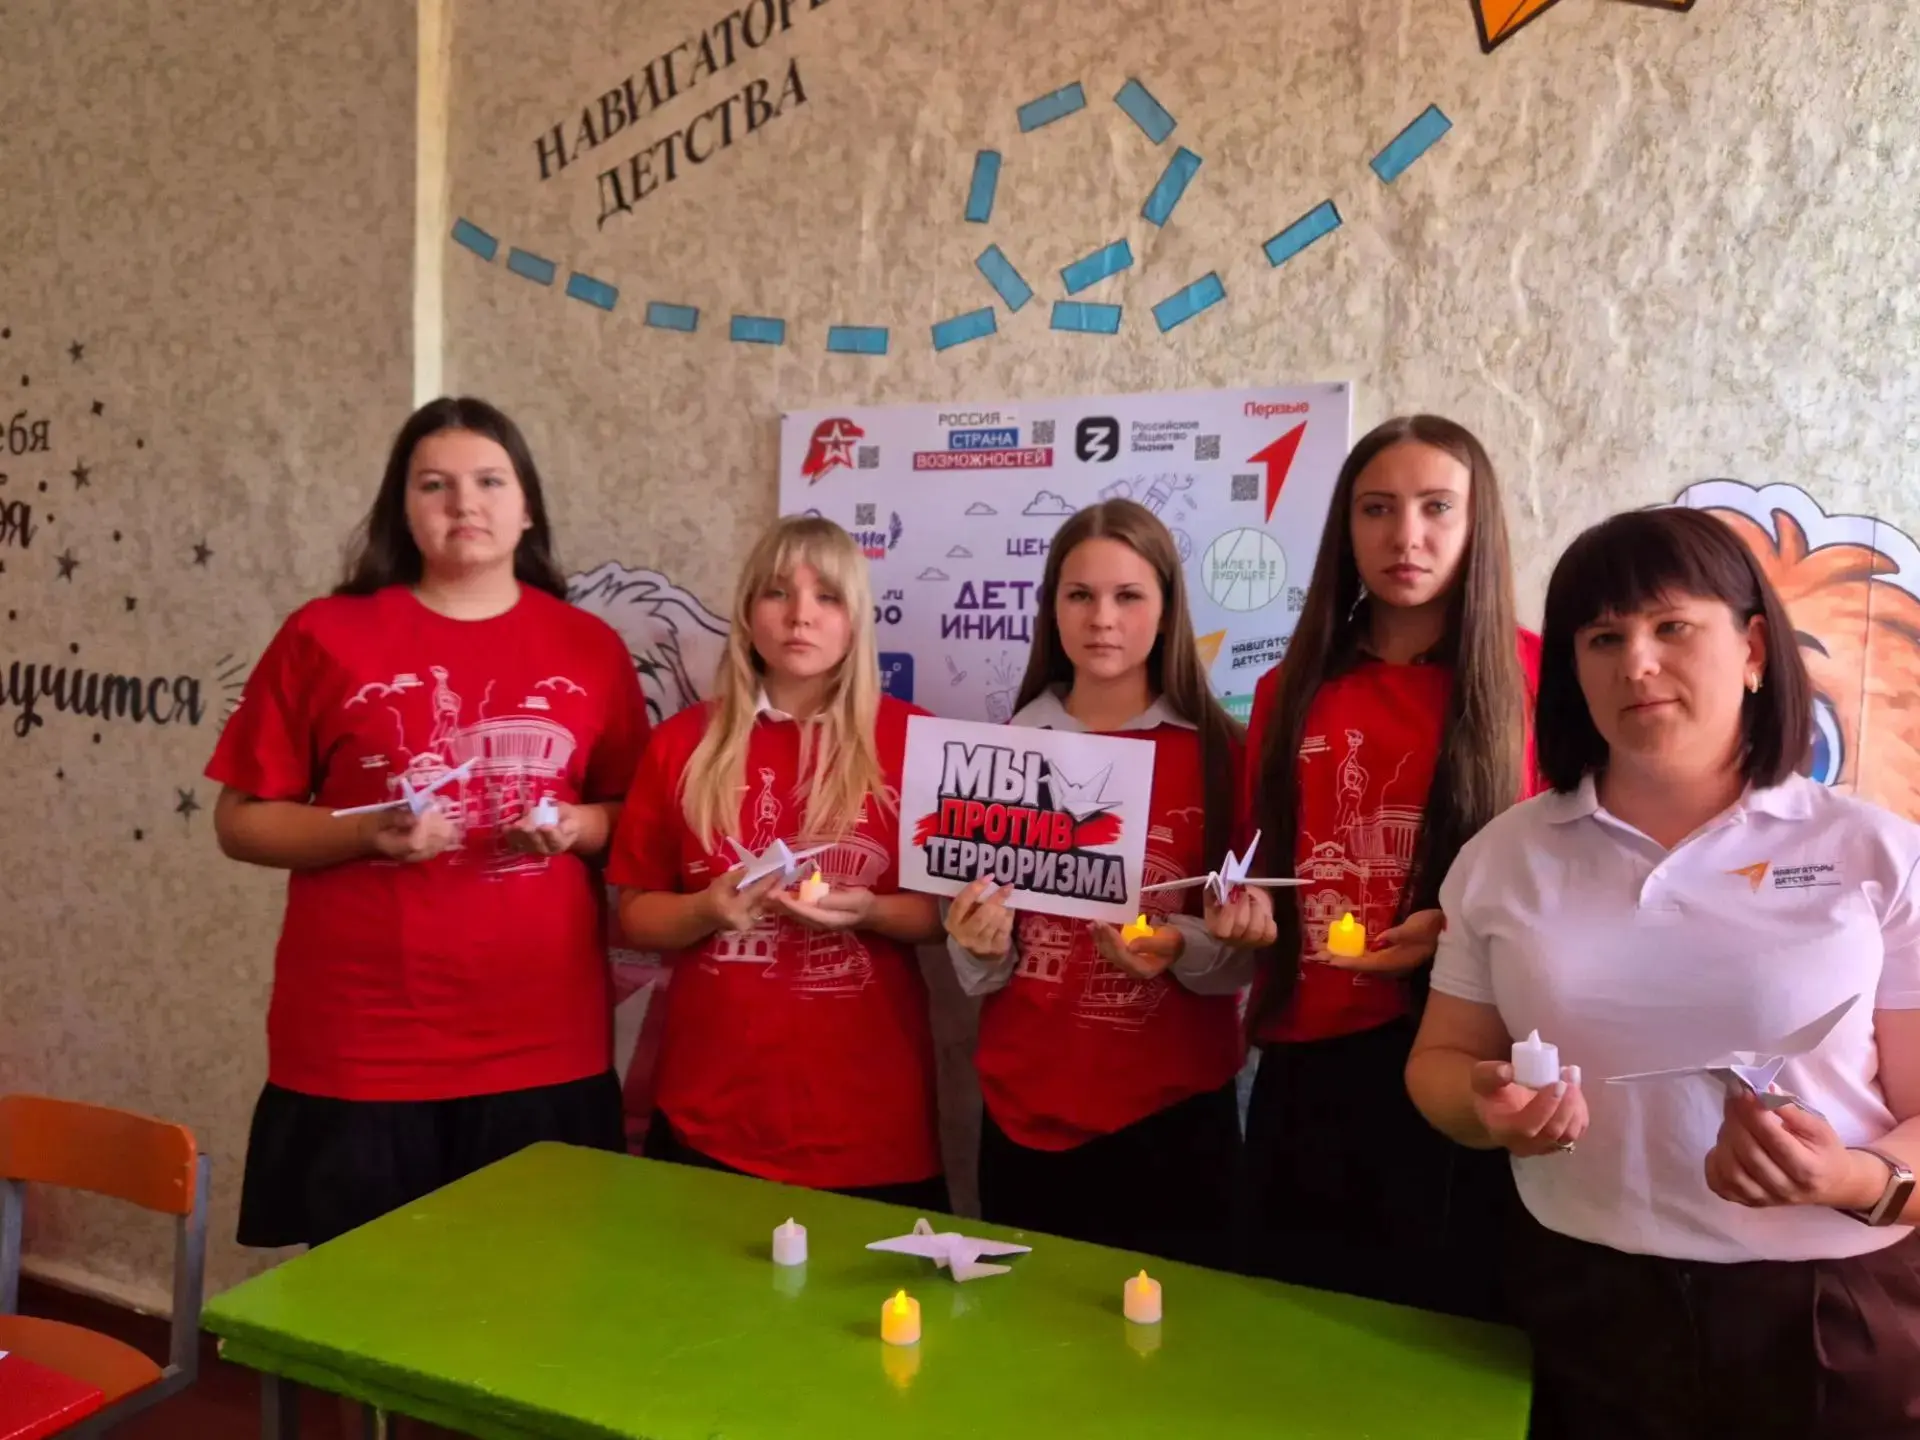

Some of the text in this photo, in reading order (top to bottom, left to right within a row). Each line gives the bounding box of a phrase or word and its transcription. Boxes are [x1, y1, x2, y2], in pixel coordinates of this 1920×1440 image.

[533, 0, 830, 182] НАВИГАТОР
[595, 57, 808, 231] ДЕТСТВА
[938, 412, 1000, 426] РОССИЯ
[1244, 401, 1310, 420] Первые
[0, 409, 51, 455] бя
[1131, 420, 1199, 431] Российское
[952, 432, 1013, 447] СТРАНА
[1131, 432, 1187, 442] общество
[1131, 442, 1175, 452] Знание
[916, 450, 1046, 468] ВОЗМОЖНОСТЕЙ
[942, 614, 1037, 643] ИНИЦ
[1231, 651, 1282, 670] ДЕТСТВА
[0, 661, 205, 737] учится
[940, 741, 1043, 807] МЫ
[940, 798, 1074, 850] ПРОТИВ
[925, 836, 1125, 901] ТЕРРОРИЗМА
[1773, 864, 1834, 876] НАВИГАТОРЫ
[1775, 875, 1816, 885] ДЕТСТВА
